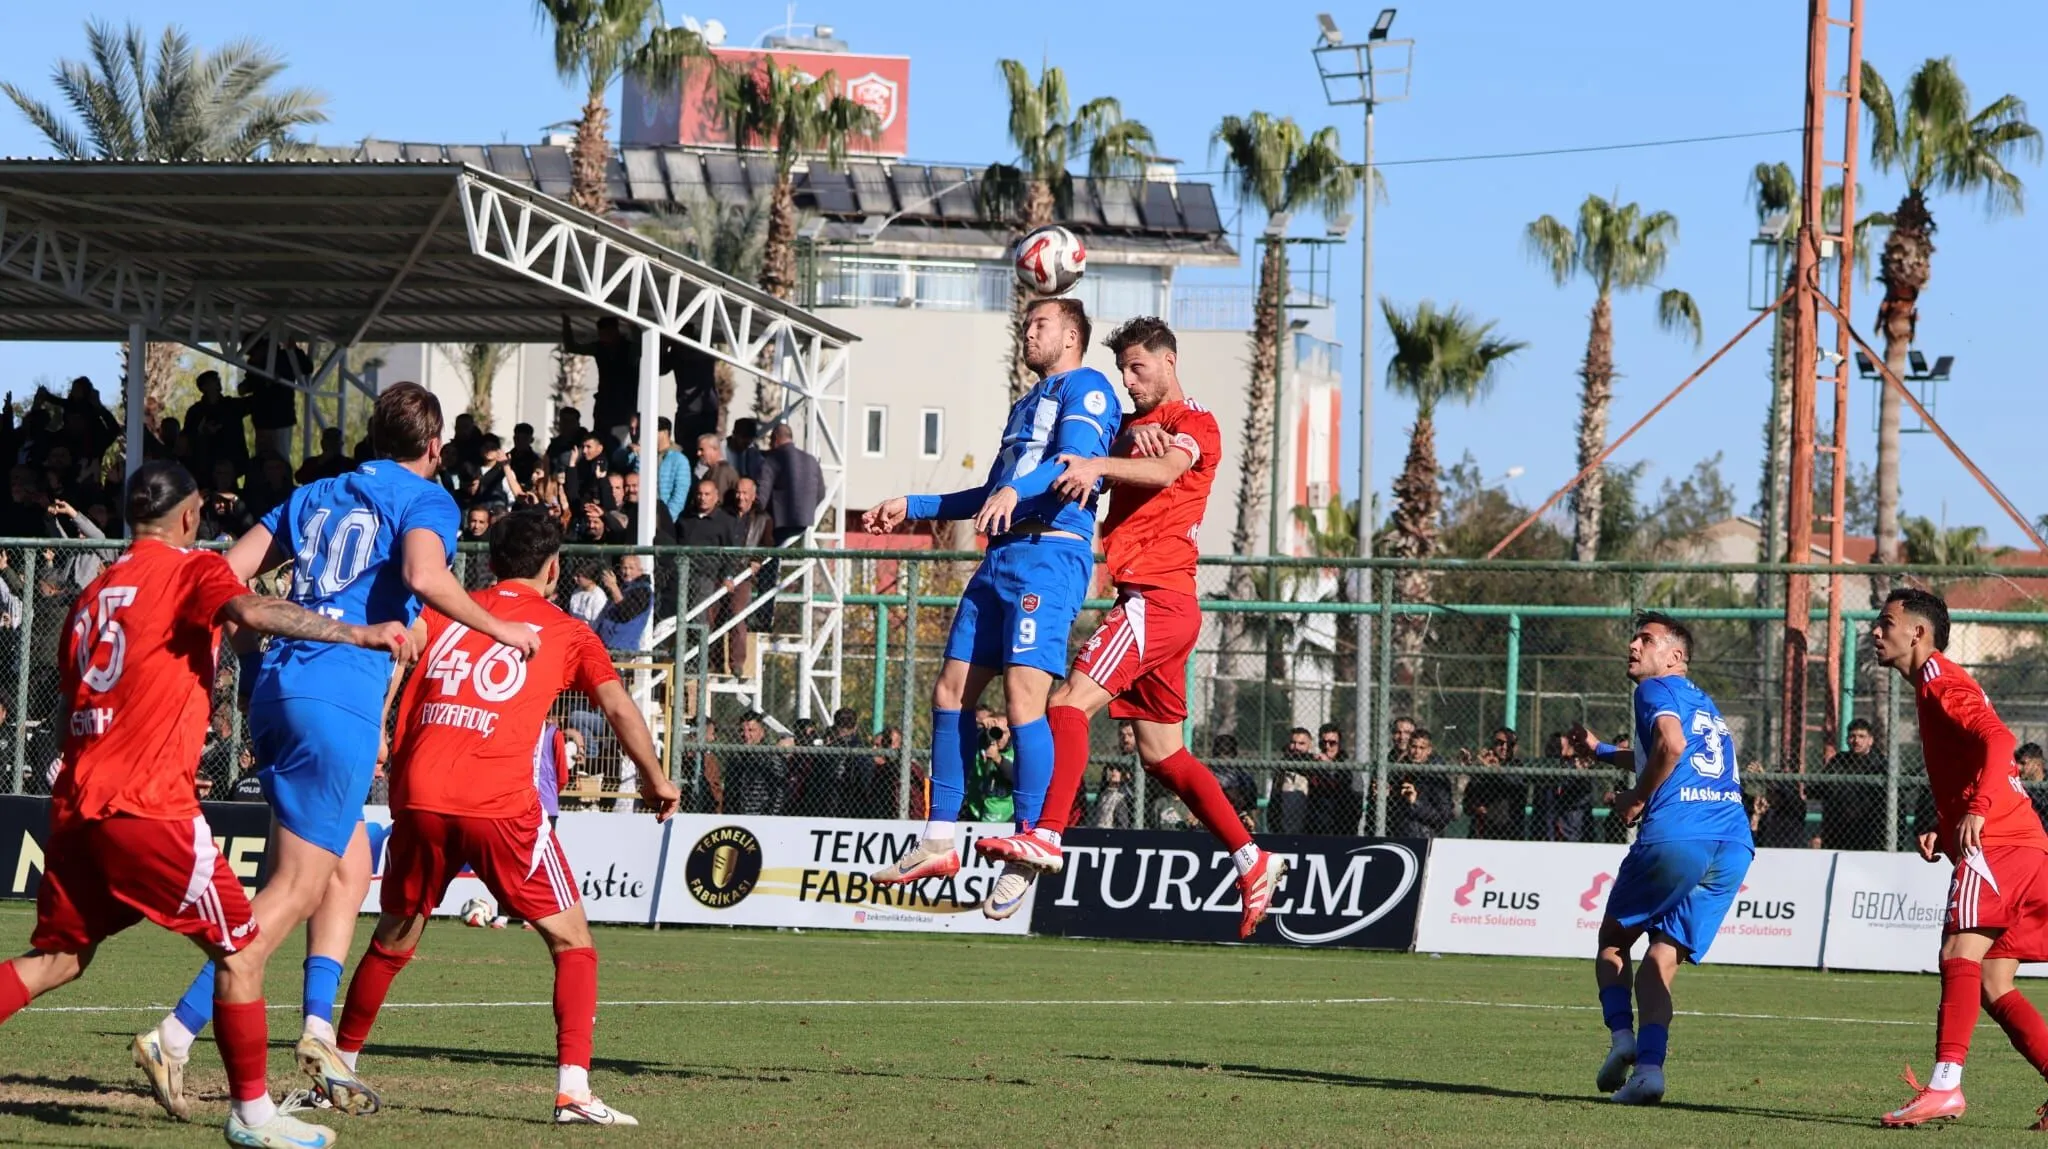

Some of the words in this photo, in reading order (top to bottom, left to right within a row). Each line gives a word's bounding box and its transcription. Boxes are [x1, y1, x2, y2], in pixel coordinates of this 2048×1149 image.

[298, 508, 380, 598] 10
[74, 586, 138, 693] 15
[1019, 617, 1037, 645] 9
[425, 620, 544, 702] 46
[696, 829, 757, 854] TEKMELİK
[810, 826, 1003, 869] TEKMİK
[582, 861, 647, 901] istic
[1054, 845, 1373, 917] TURZEM
[1482, 890, 1541, 910] PLUS
[1736, 900, 1796, 920] PLUS
[1851, 891, 1908, 920] GBOX
[1907, 900, 1948, 924] desig
[1450, 912, 1482, 925] Event
[1484, 914, 1537, 927] Solutions
[1718, 924, 1736, 935] ent
[1738, 924, 1792, 937] Solutions
